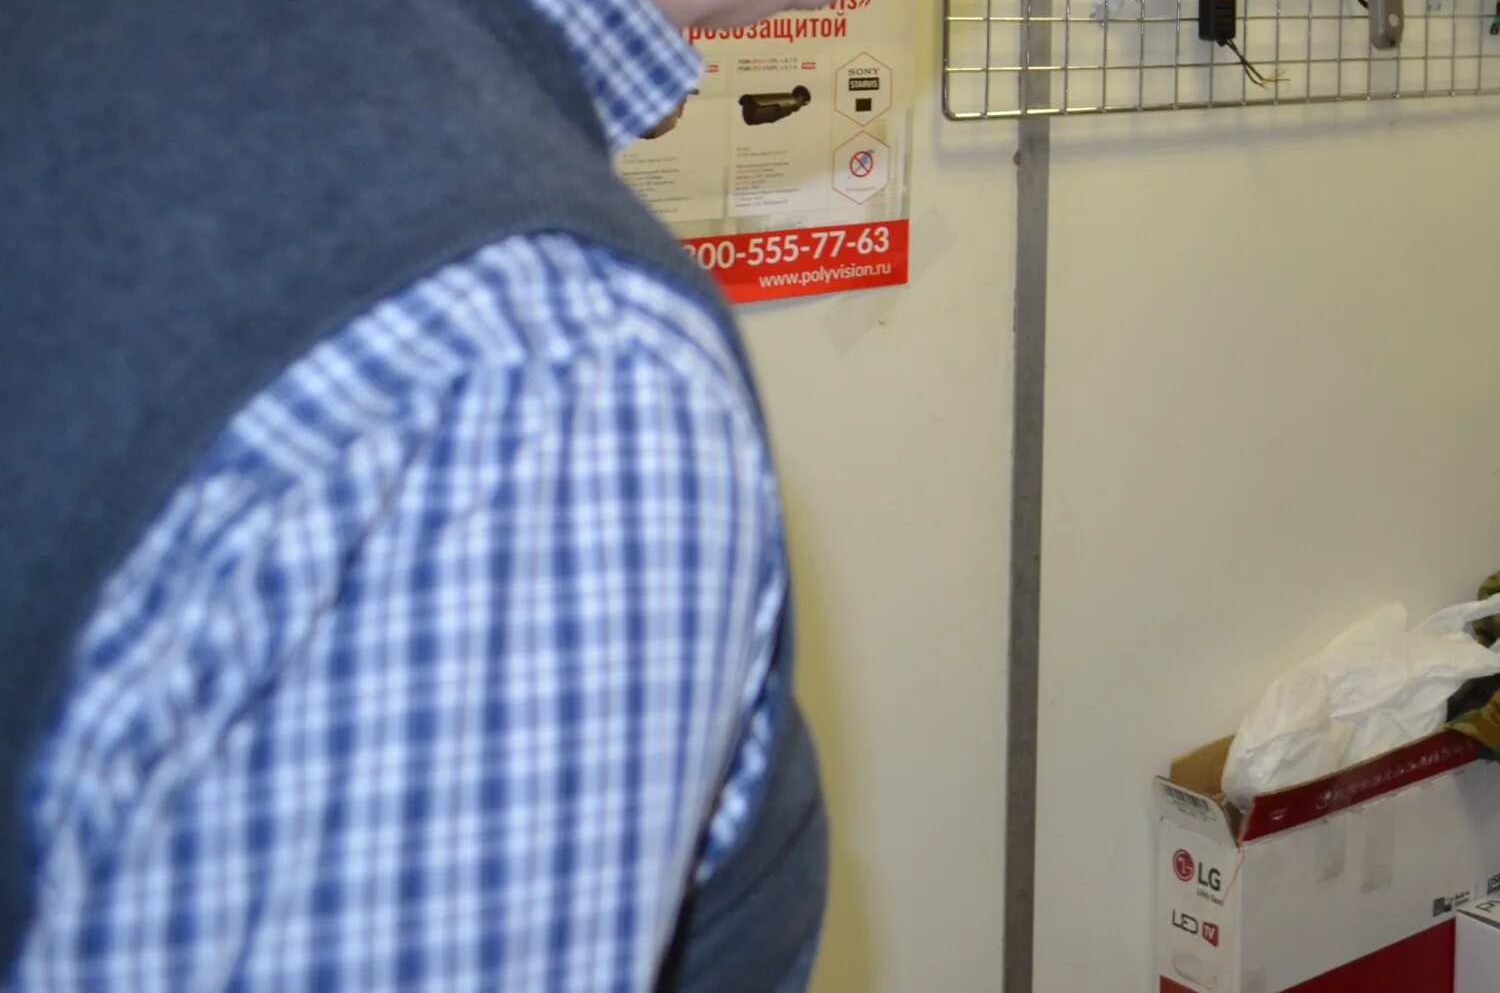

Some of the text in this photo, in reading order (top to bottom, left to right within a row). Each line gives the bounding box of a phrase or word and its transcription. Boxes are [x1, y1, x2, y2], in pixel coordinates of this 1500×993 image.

[687, 11, 847, 46] розозащитой
[848, 68, 879, 76] SONY
[759, 262, 891, 288] www.polyvision.ru
[1197, 862, 1221, 892] LG
[1172, 909, 1199, 935] LED
